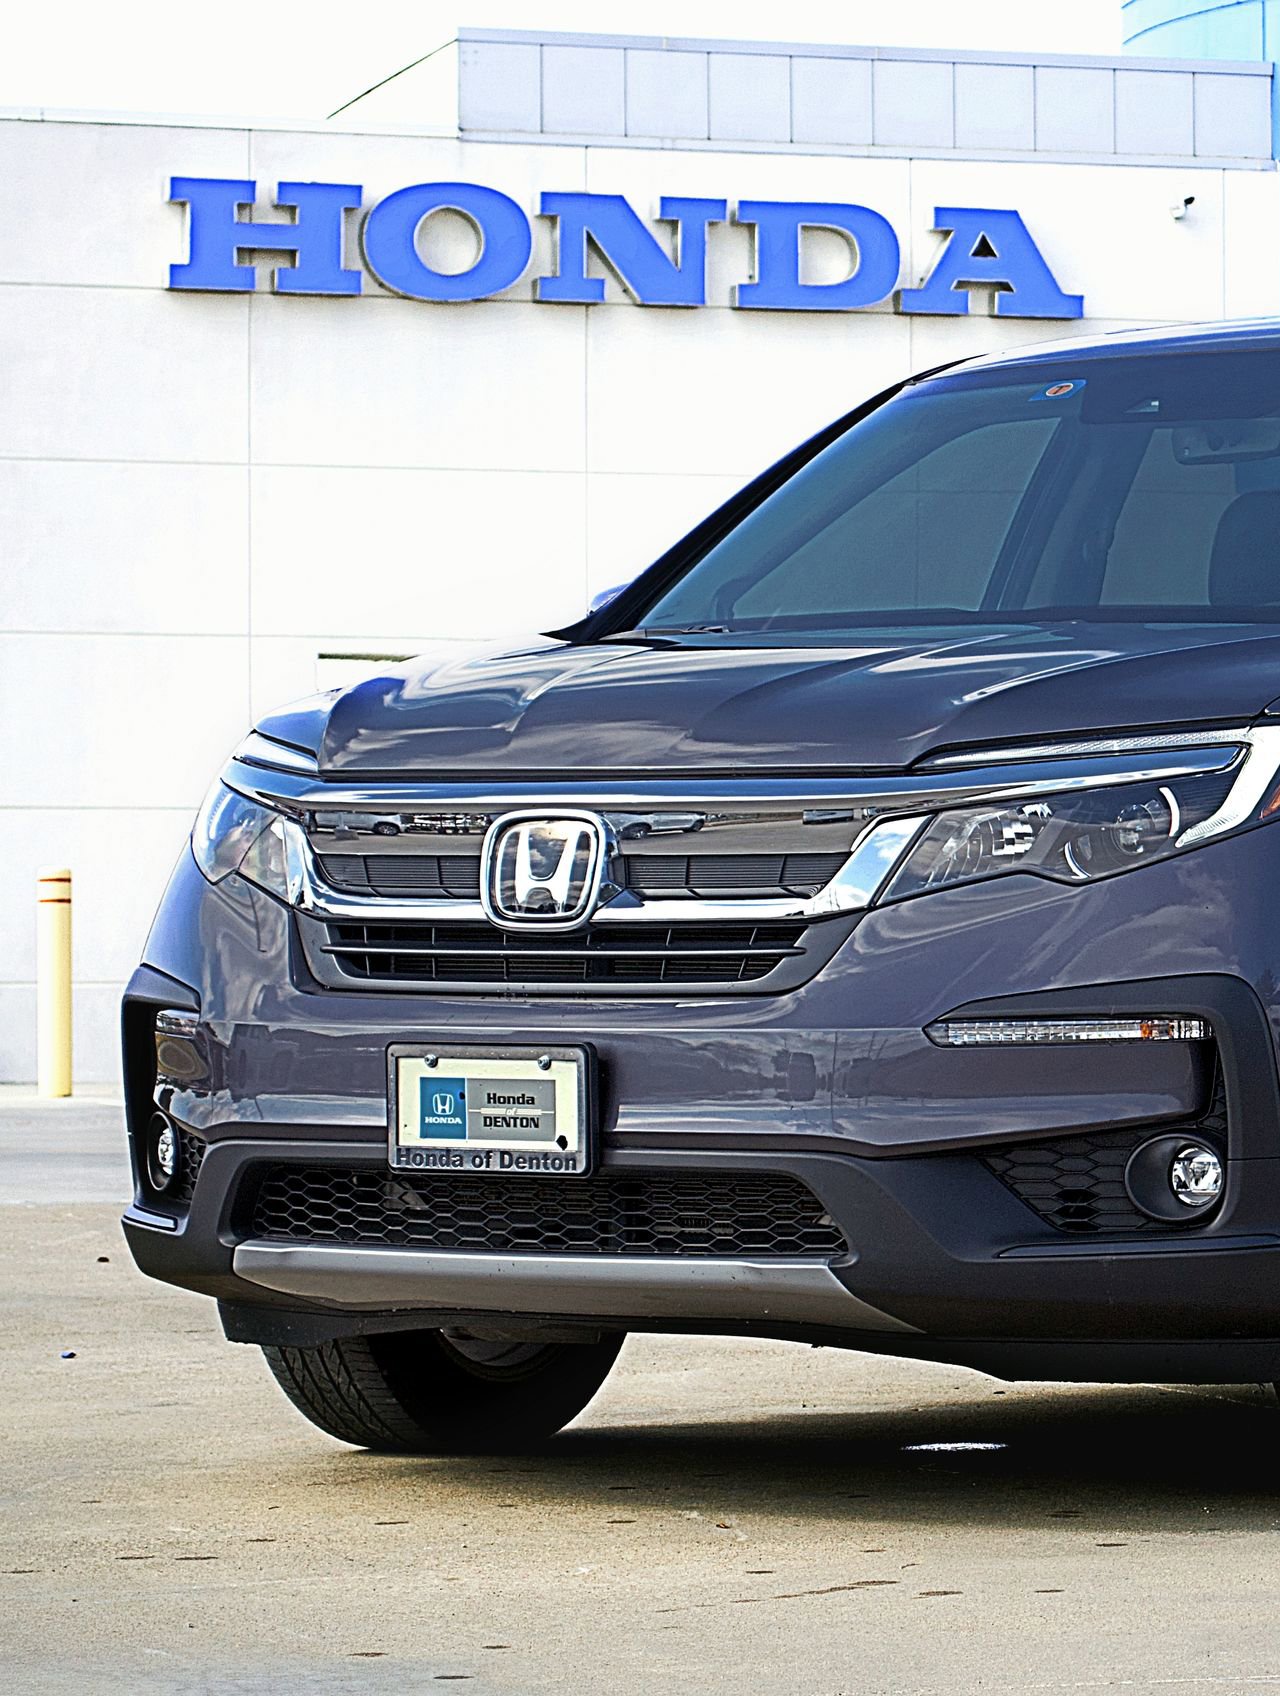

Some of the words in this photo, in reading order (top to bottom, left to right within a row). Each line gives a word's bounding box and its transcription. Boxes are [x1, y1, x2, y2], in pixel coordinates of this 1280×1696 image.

[167, 176, 1085, 319] HONDA
[486, 1092, 536, 1106] Honda
[505, 1107, 517, 1116] of
[424, 1116, 463, 1125] HONDA
[483, 1115, 540, 1129] DENTON
[395, 1147, 464, 1168] Honda
[471, 1150, 493, 1169] of
[500, 1150, 577, 1172] Denton
